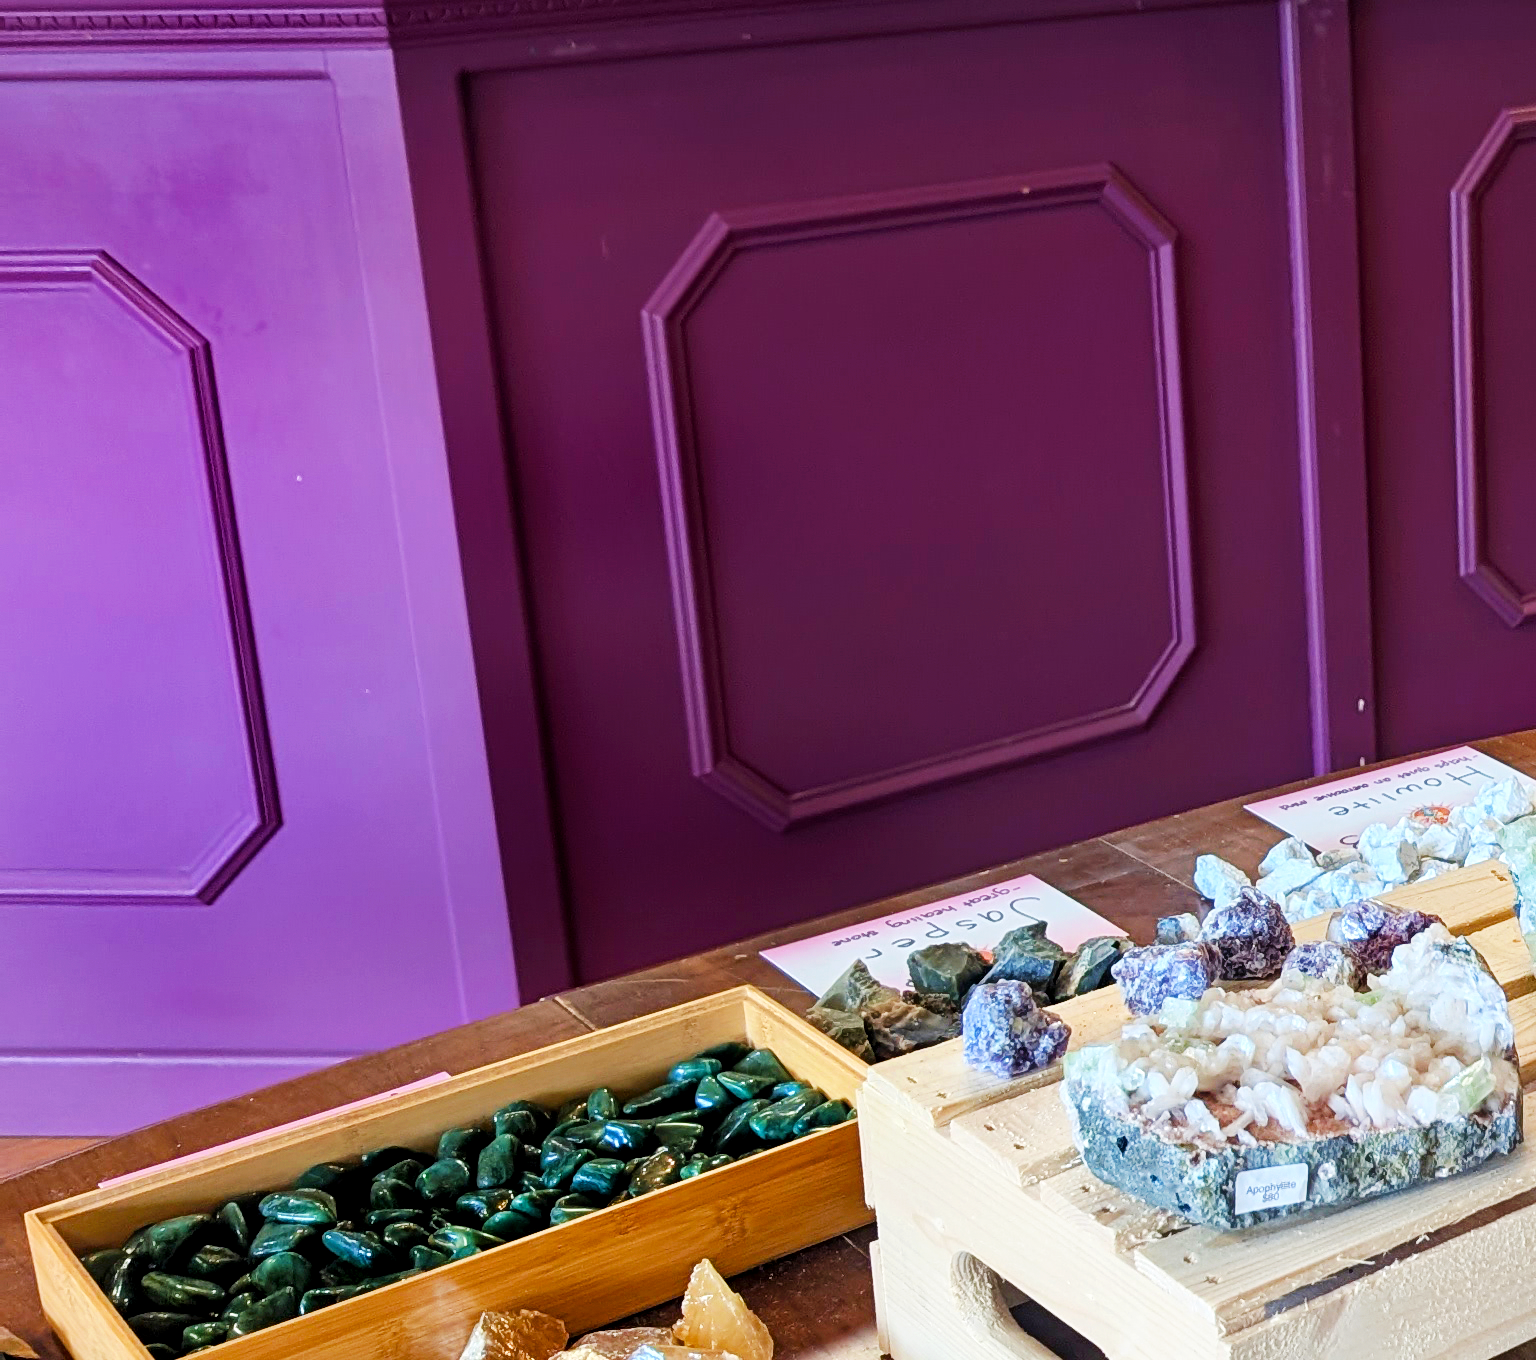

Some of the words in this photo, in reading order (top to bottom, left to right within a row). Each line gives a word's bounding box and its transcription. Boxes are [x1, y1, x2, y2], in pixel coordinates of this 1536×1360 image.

[1328, 765, 1495, 816] Howlite
[1374, 776, 1392, 785] an
[865, 896, 1041, 960] Jasper
[885, 905, 957, 928] healing
[831, 929, 879, 947] stone
